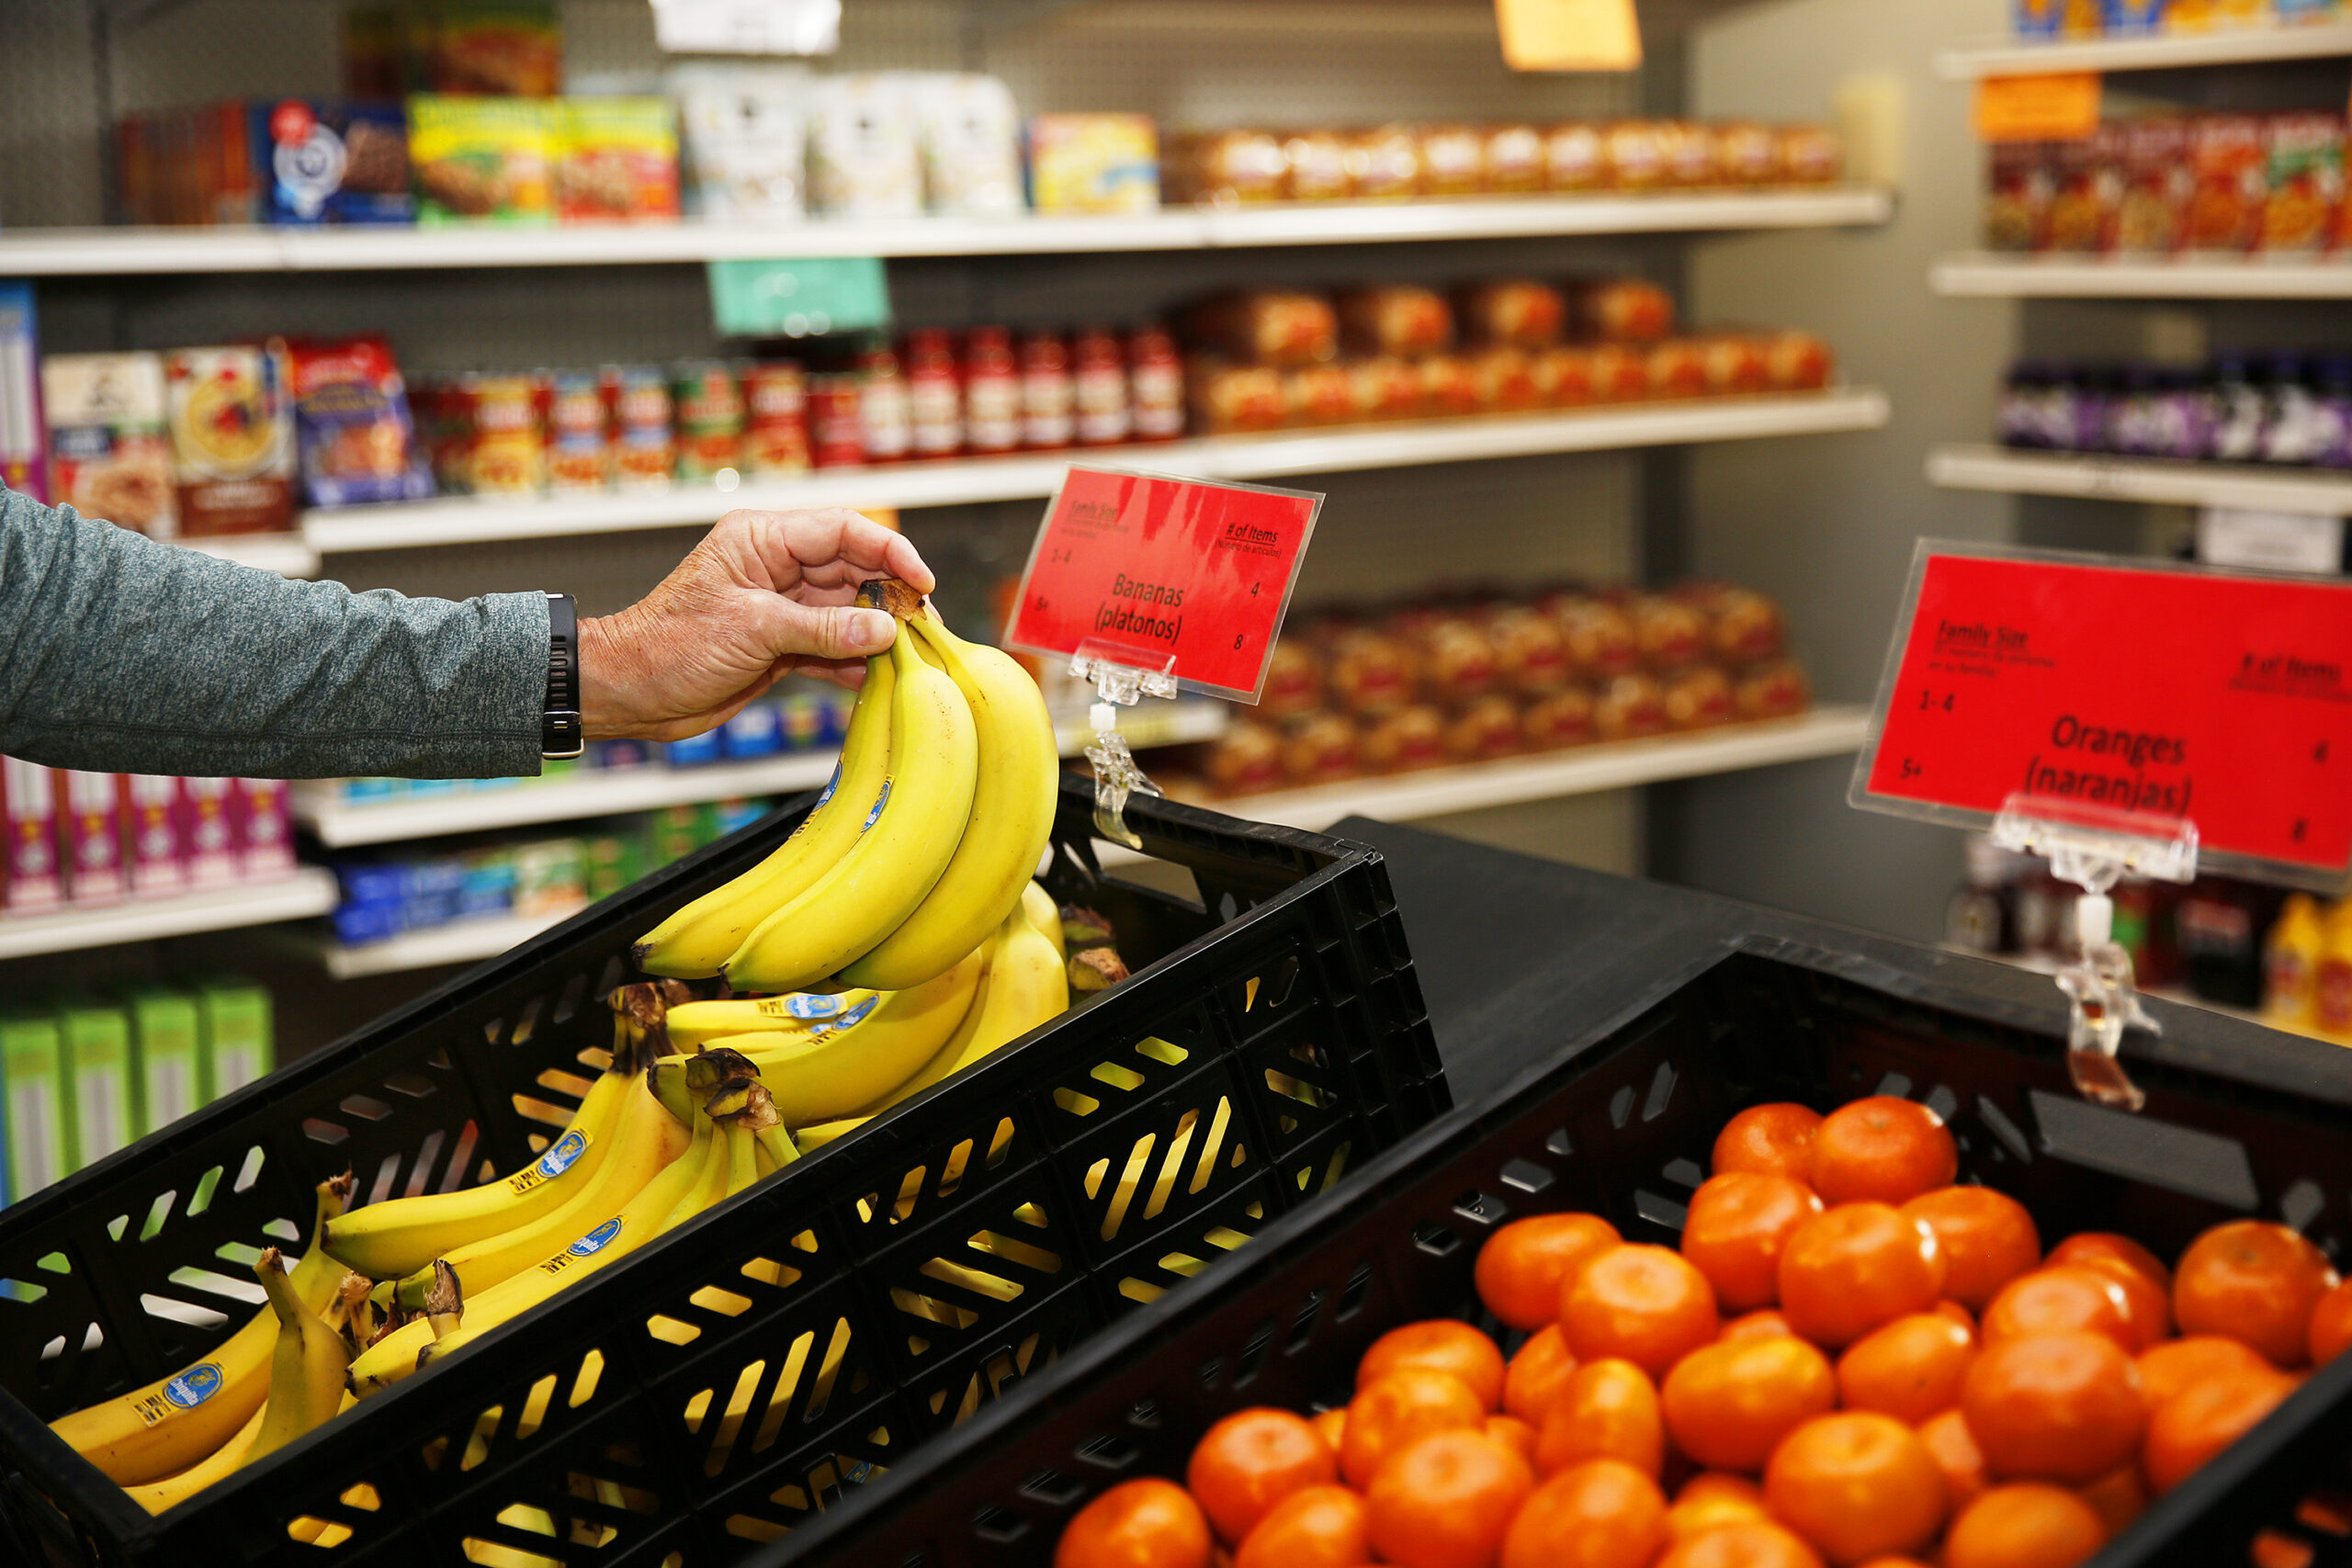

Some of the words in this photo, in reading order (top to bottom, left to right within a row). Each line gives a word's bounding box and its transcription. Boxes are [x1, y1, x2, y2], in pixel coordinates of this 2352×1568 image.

[1236, 525, 1250, 538] of
[1249, 526, 1278, 543] Items
[1112, 572, 1184, 607] Bananas
[1250, 581, 1261, 599] 4
[1094, 602, 1182, 647] (platonos)
[1938, 619, 1992, 648] Family
[1234, 634, 1244, 650] 8
[2052, 715, 2187, 769] Oranges
[2025, 755, 2193, 819] (naranjas)
